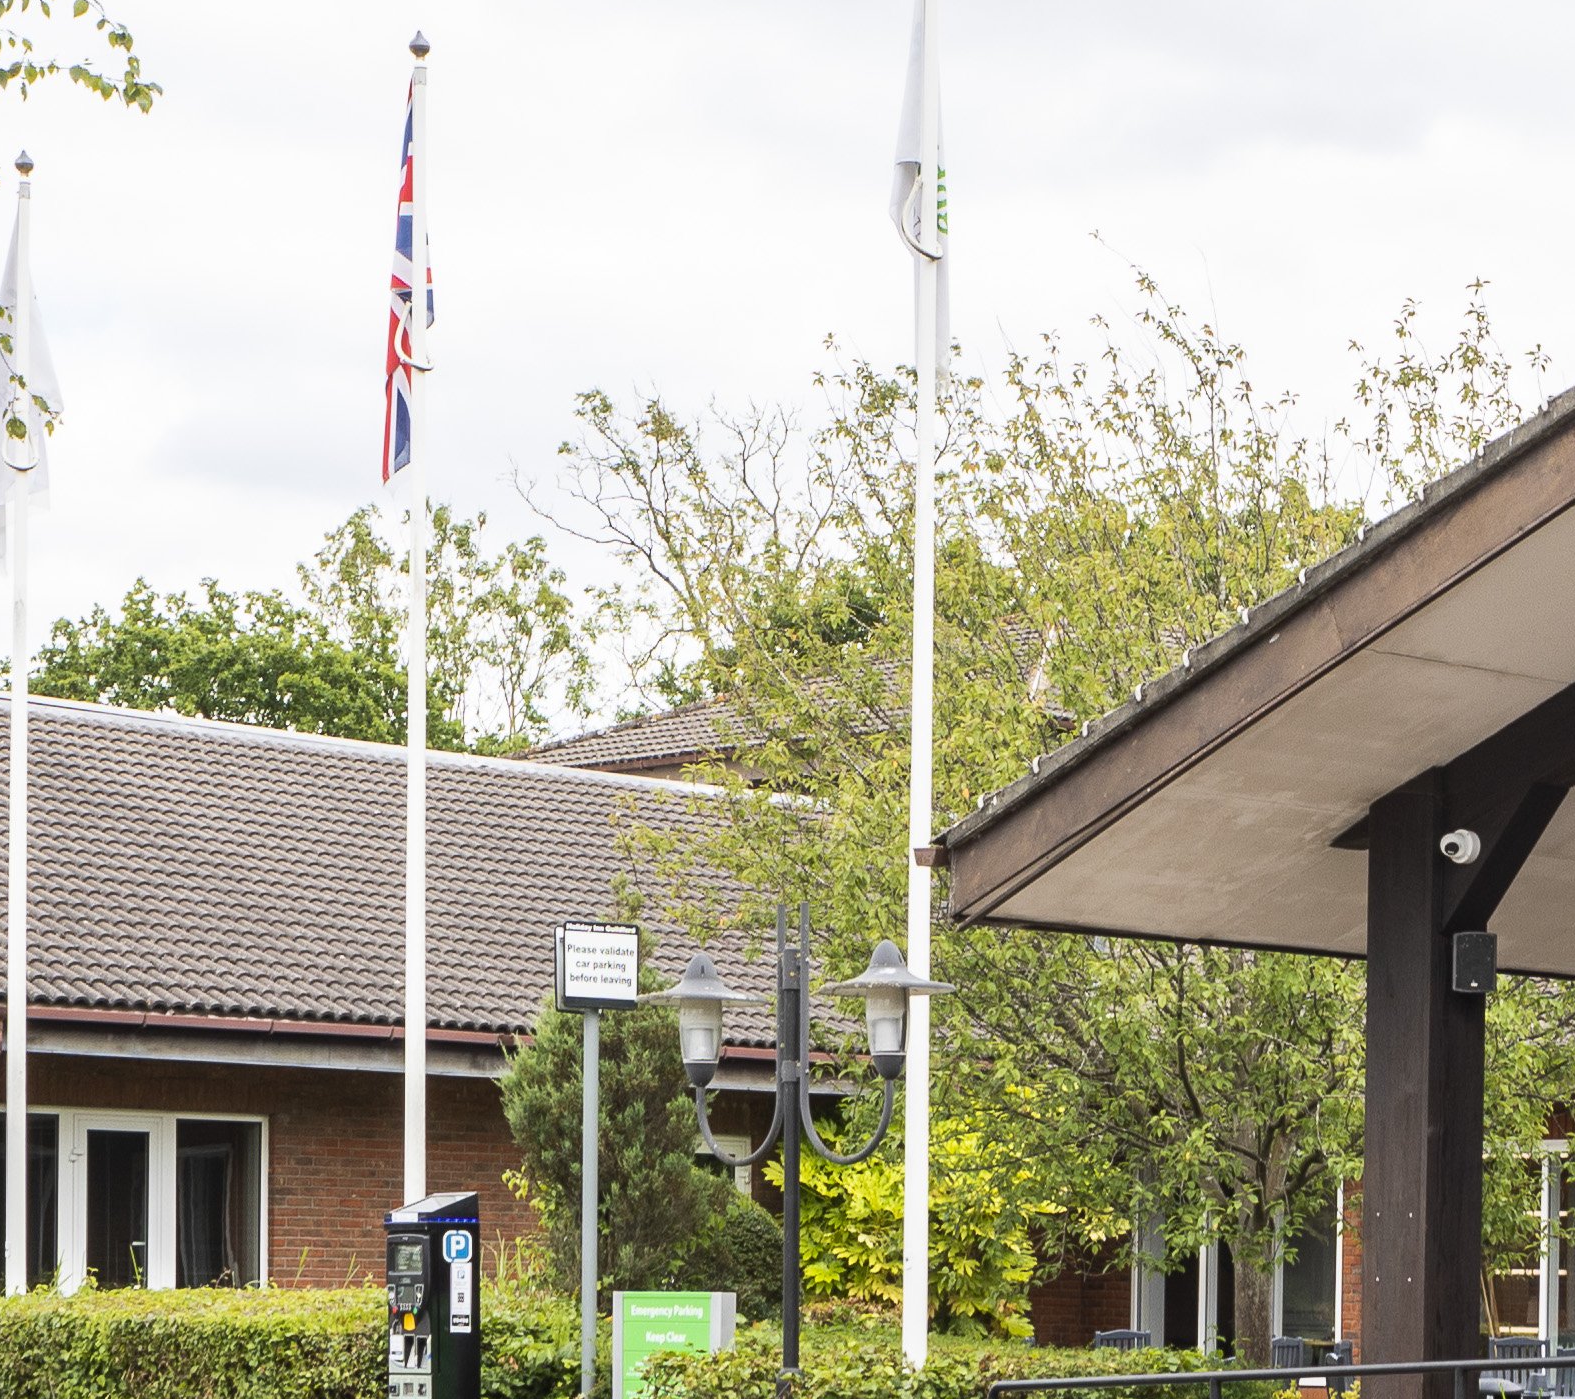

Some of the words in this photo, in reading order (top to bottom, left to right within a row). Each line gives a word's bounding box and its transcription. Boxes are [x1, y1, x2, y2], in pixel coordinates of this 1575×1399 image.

[567, 944, 597, 954] Please
[600, 947, 635, 957] validate
[593, 961, 626, 972] parking
[570, 973, 598, 983] before
[601, 974, 632, 987] leaving
[450, 1235, 466, 1258] P
[631, 1304, 673, 1319] Emergency
[673, 1304, 704, 1320] Parking
[645, 1331, 666, 1344] Keep
[666, 1331, 687, 1343] Clear
